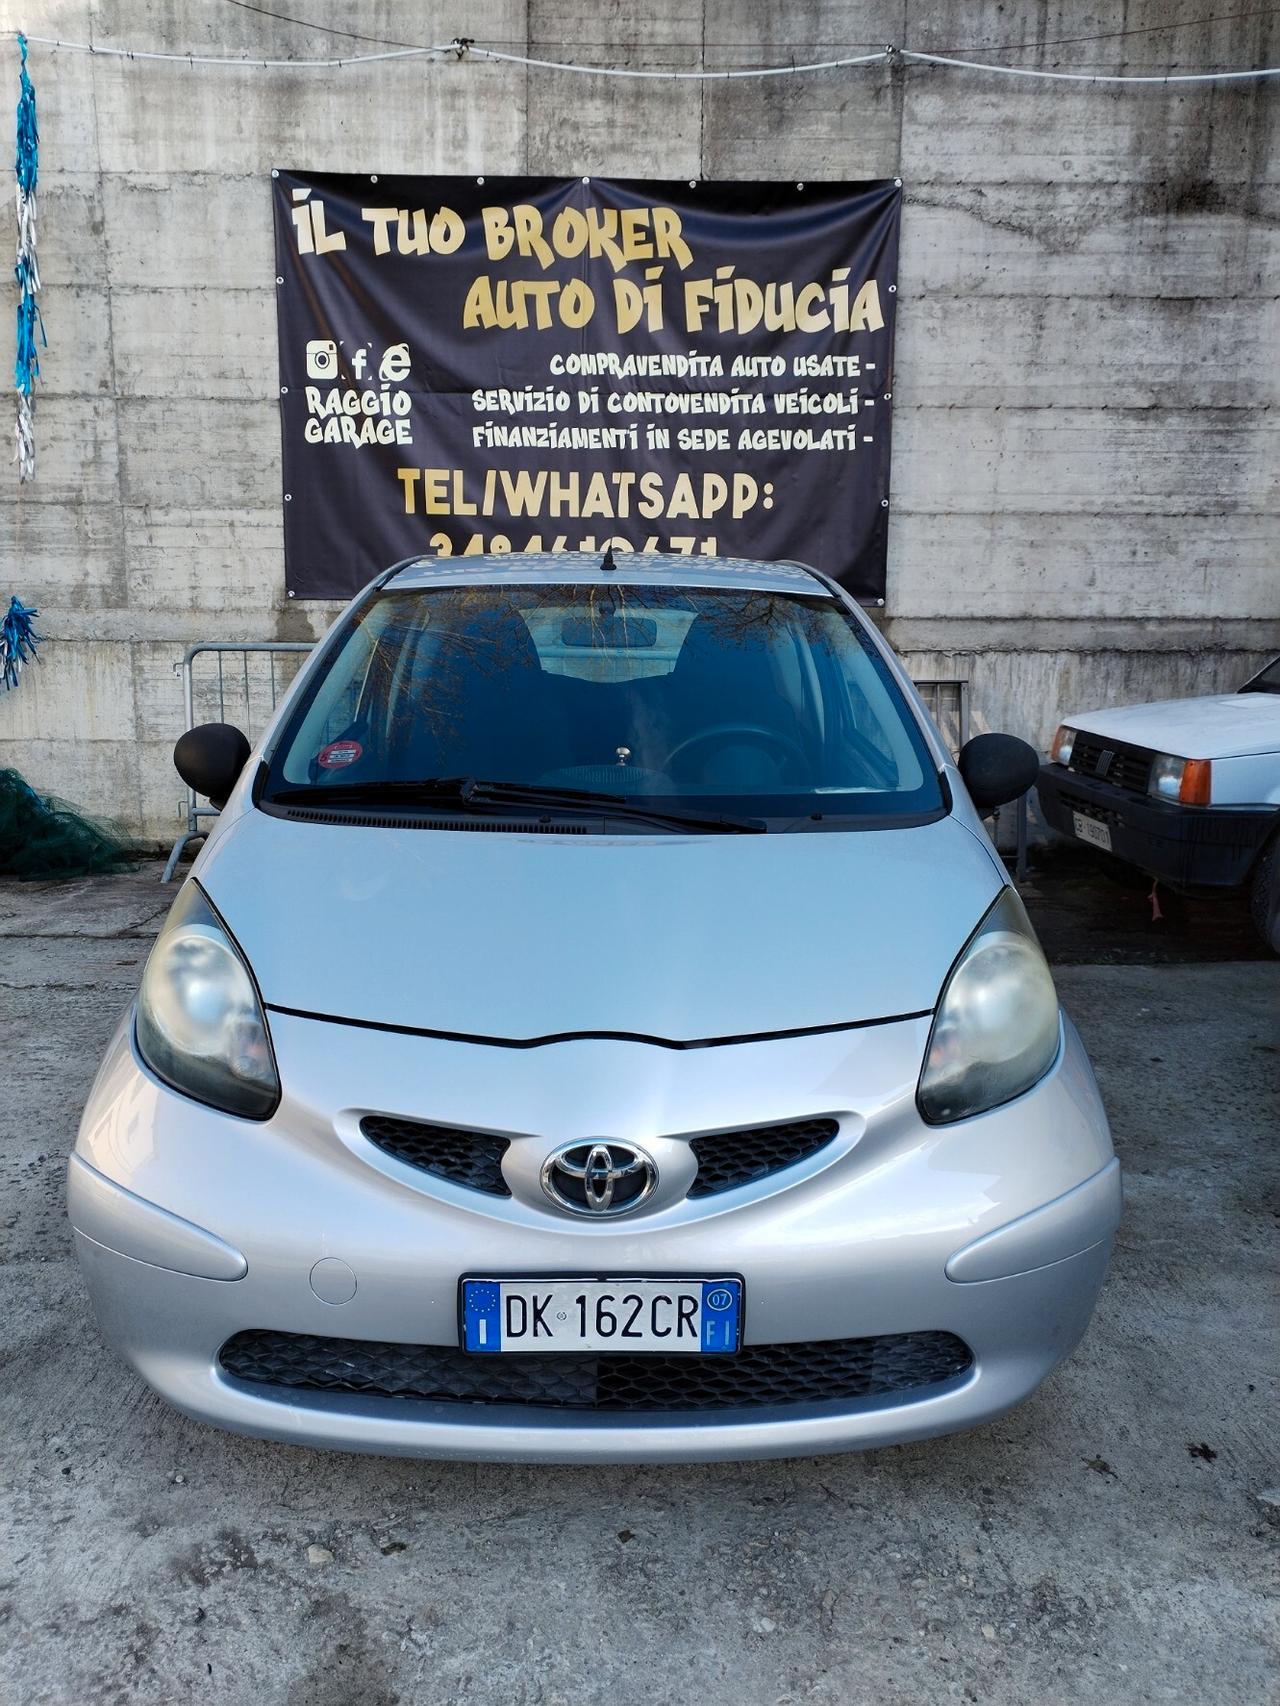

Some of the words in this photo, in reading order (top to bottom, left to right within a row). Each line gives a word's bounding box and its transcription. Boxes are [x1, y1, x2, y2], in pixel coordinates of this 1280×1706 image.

[361, 206, 466, 256] TUO
[481, 204, 694, 273] BROKER
[463, 276, 595, 330] AUTO
[612, 266, 664, 335] DI
[684, 265, 885, 335] FIDUCIA
[549, 350, 724, 379] COMPRAVENDITA
[731, 355, 786, 377] AUTO
[793, 355, 861, 377] USATE
[305, 384, 412, 419] RAGGIO
[472, 385, 571, 415] SERVIZIO
[578, 387, 599, 415] DI
[607, 388, 766, 415] CONTOVENDITA
[774, 387, 859, 415] VEICOLI
[304, 417, 413, 449] GARAGE
[472, 421, 639, 450] FINANZIAMENTI
[646, 424, 670, 450] IN
[677, 428, 731, 451] SEDE
[737, 424, 857, 451] AGEVOLATI
[397, 468, 774, 519] TEL/WHATSAPP:
[505, 1294, 554, 1338] DK
[575, 1294, 699, 1338] 162CR
[712, 1294, 728, 1307] 07
